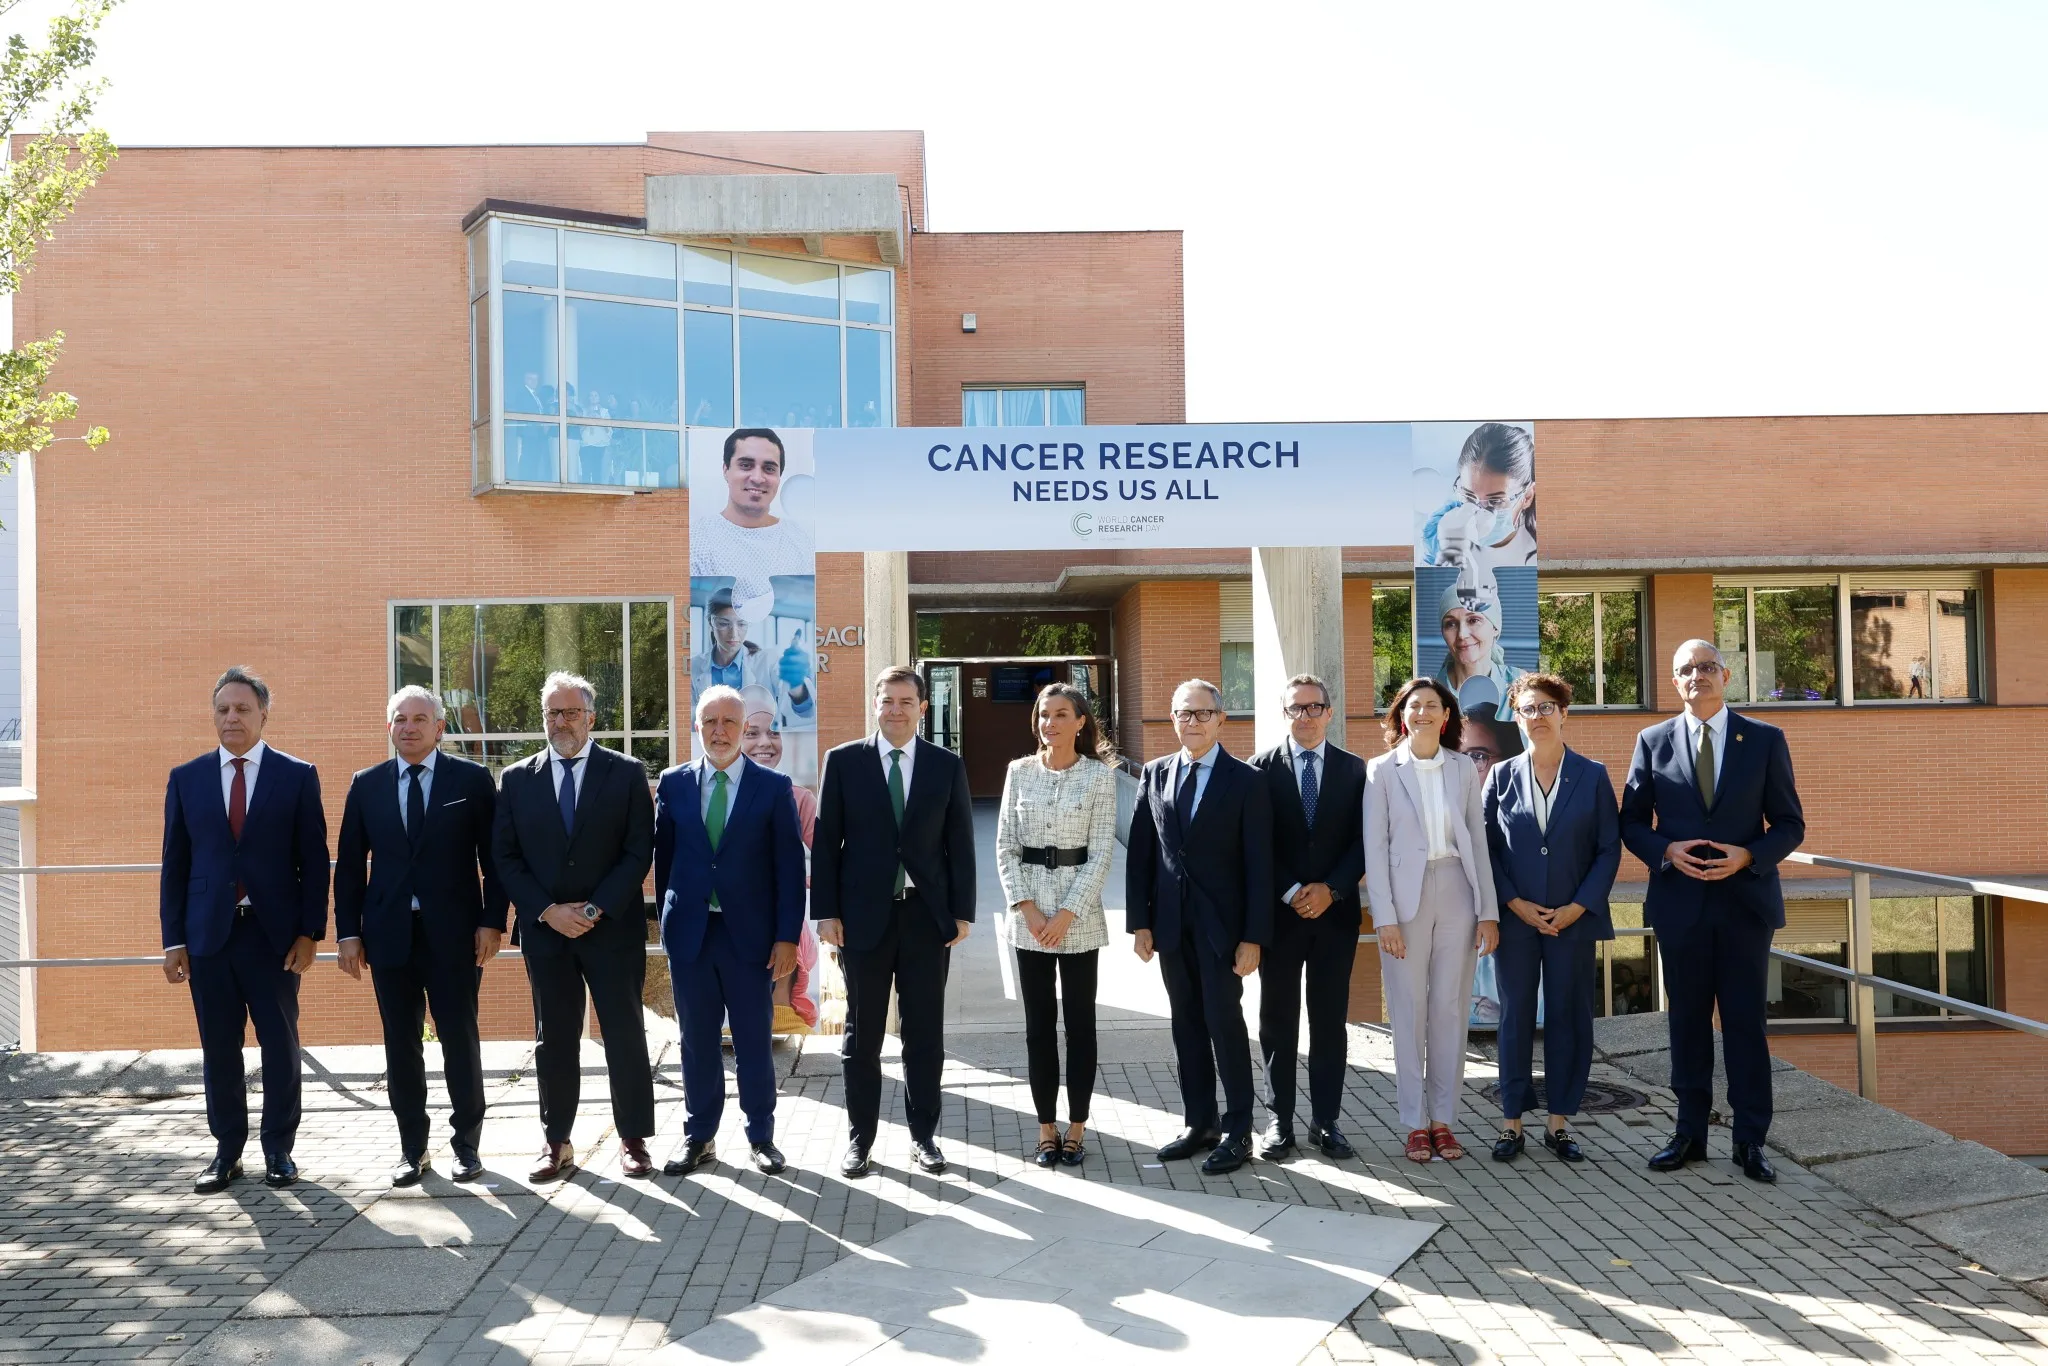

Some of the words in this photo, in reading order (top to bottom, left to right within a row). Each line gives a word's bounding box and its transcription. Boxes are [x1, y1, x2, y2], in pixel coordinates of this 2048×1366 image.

[927, 443, 1085, 472] CANCER
[1099, 441, 1299, 470] RESEARCH
[1013, 480, 1109, 502] NEEDS
[1118, 479, 1157, 501] US
[1165, 479, 1219, 501] ALL
[1097, 516, 1128, 524] WORLD
[1130, 515, 1165, 523] CANCER
[1098, 525, 1143, 533] RESEARCH
